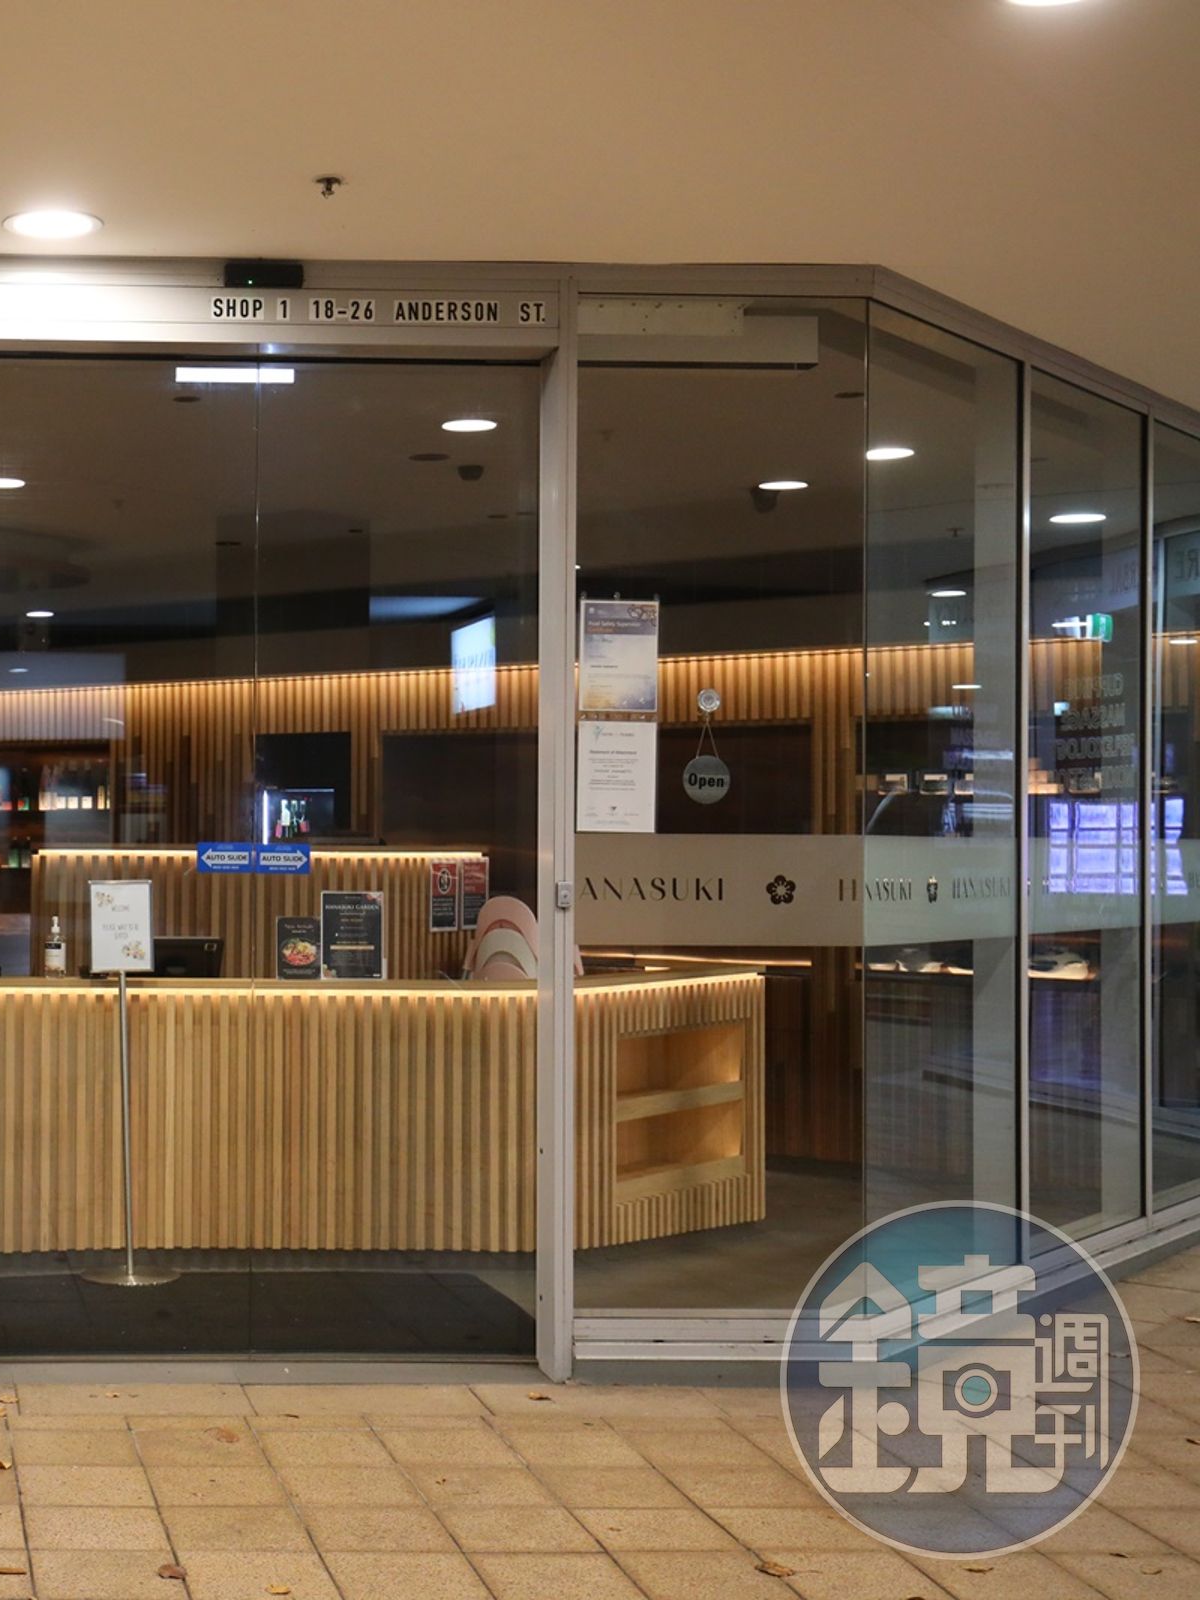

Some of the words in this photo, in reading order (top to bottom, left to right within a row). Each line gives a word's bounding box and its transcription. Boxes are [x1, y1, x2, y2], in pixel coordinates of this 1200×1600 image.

[213, 298, 263, 318] SHOP
[281, 300, 288, 318] 1
[313, 300, 373, 320] 18-26
[395, 302, 498, 321] ANDERSON
[520, 303, 546, 322] ST.
[687, 773, 724, 790] Open
